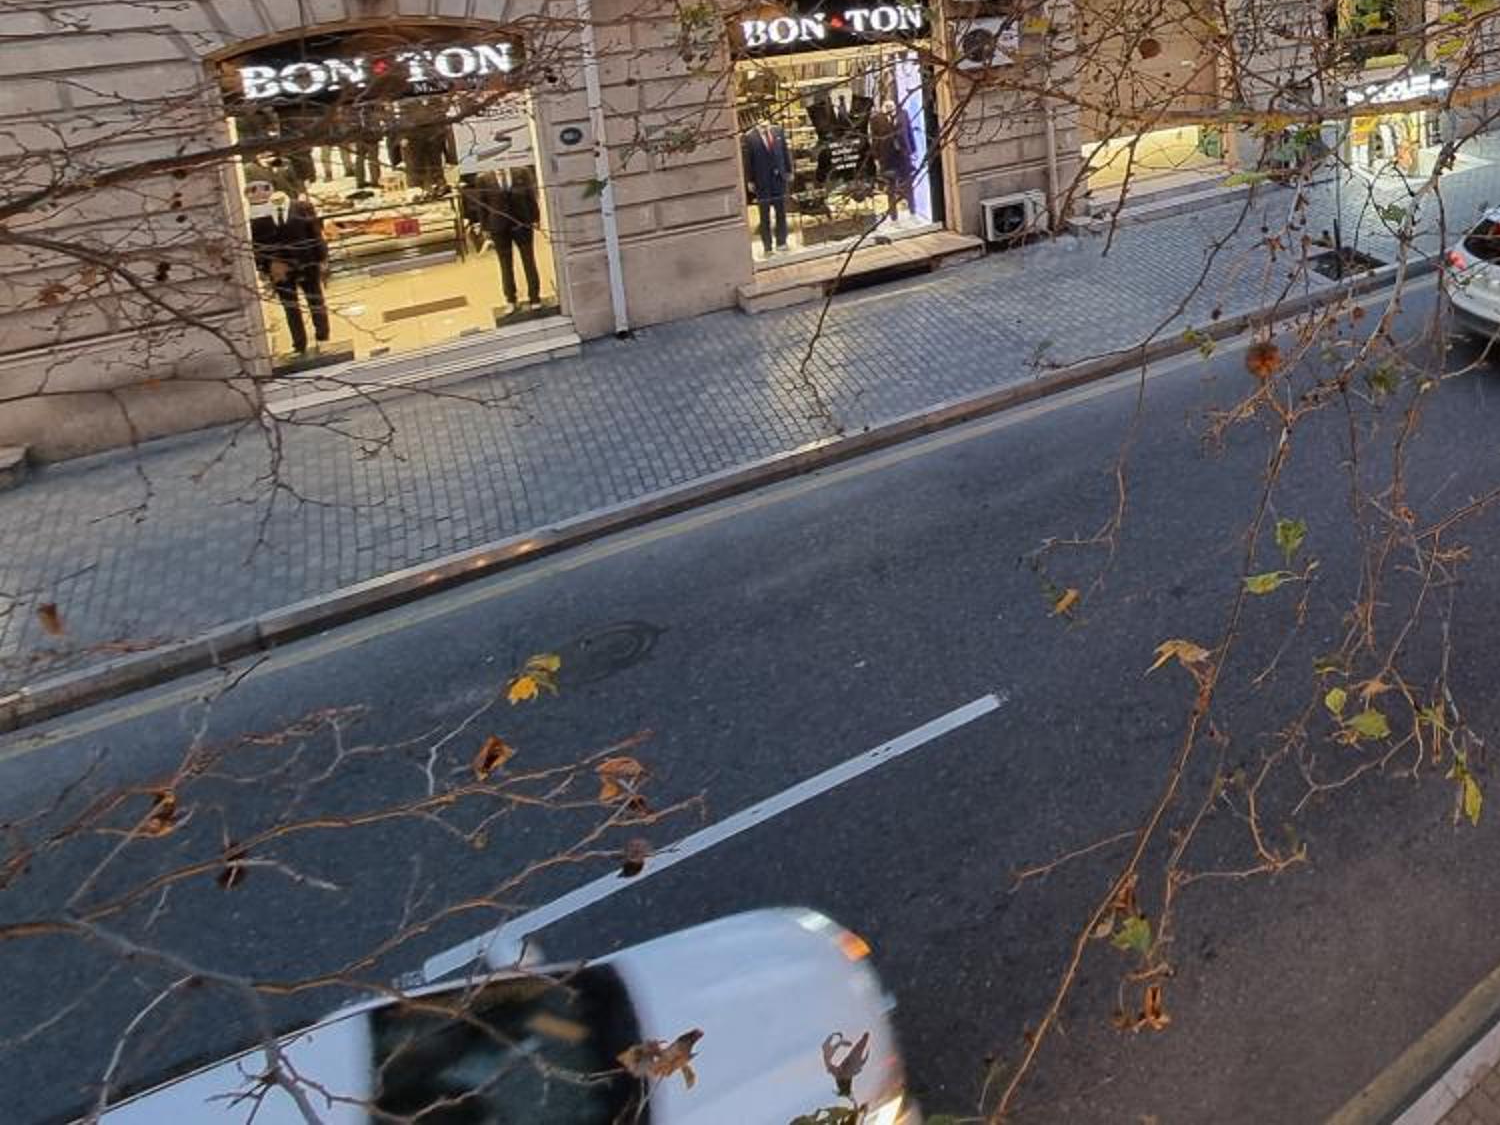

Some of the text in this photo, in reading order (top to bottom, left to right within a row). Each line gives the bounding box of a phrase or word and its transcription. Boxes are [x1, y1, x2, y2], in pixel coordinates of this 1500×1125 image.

[740, 4, 923, 46] BON TON
[238, 42, 513, 100] BON TON
